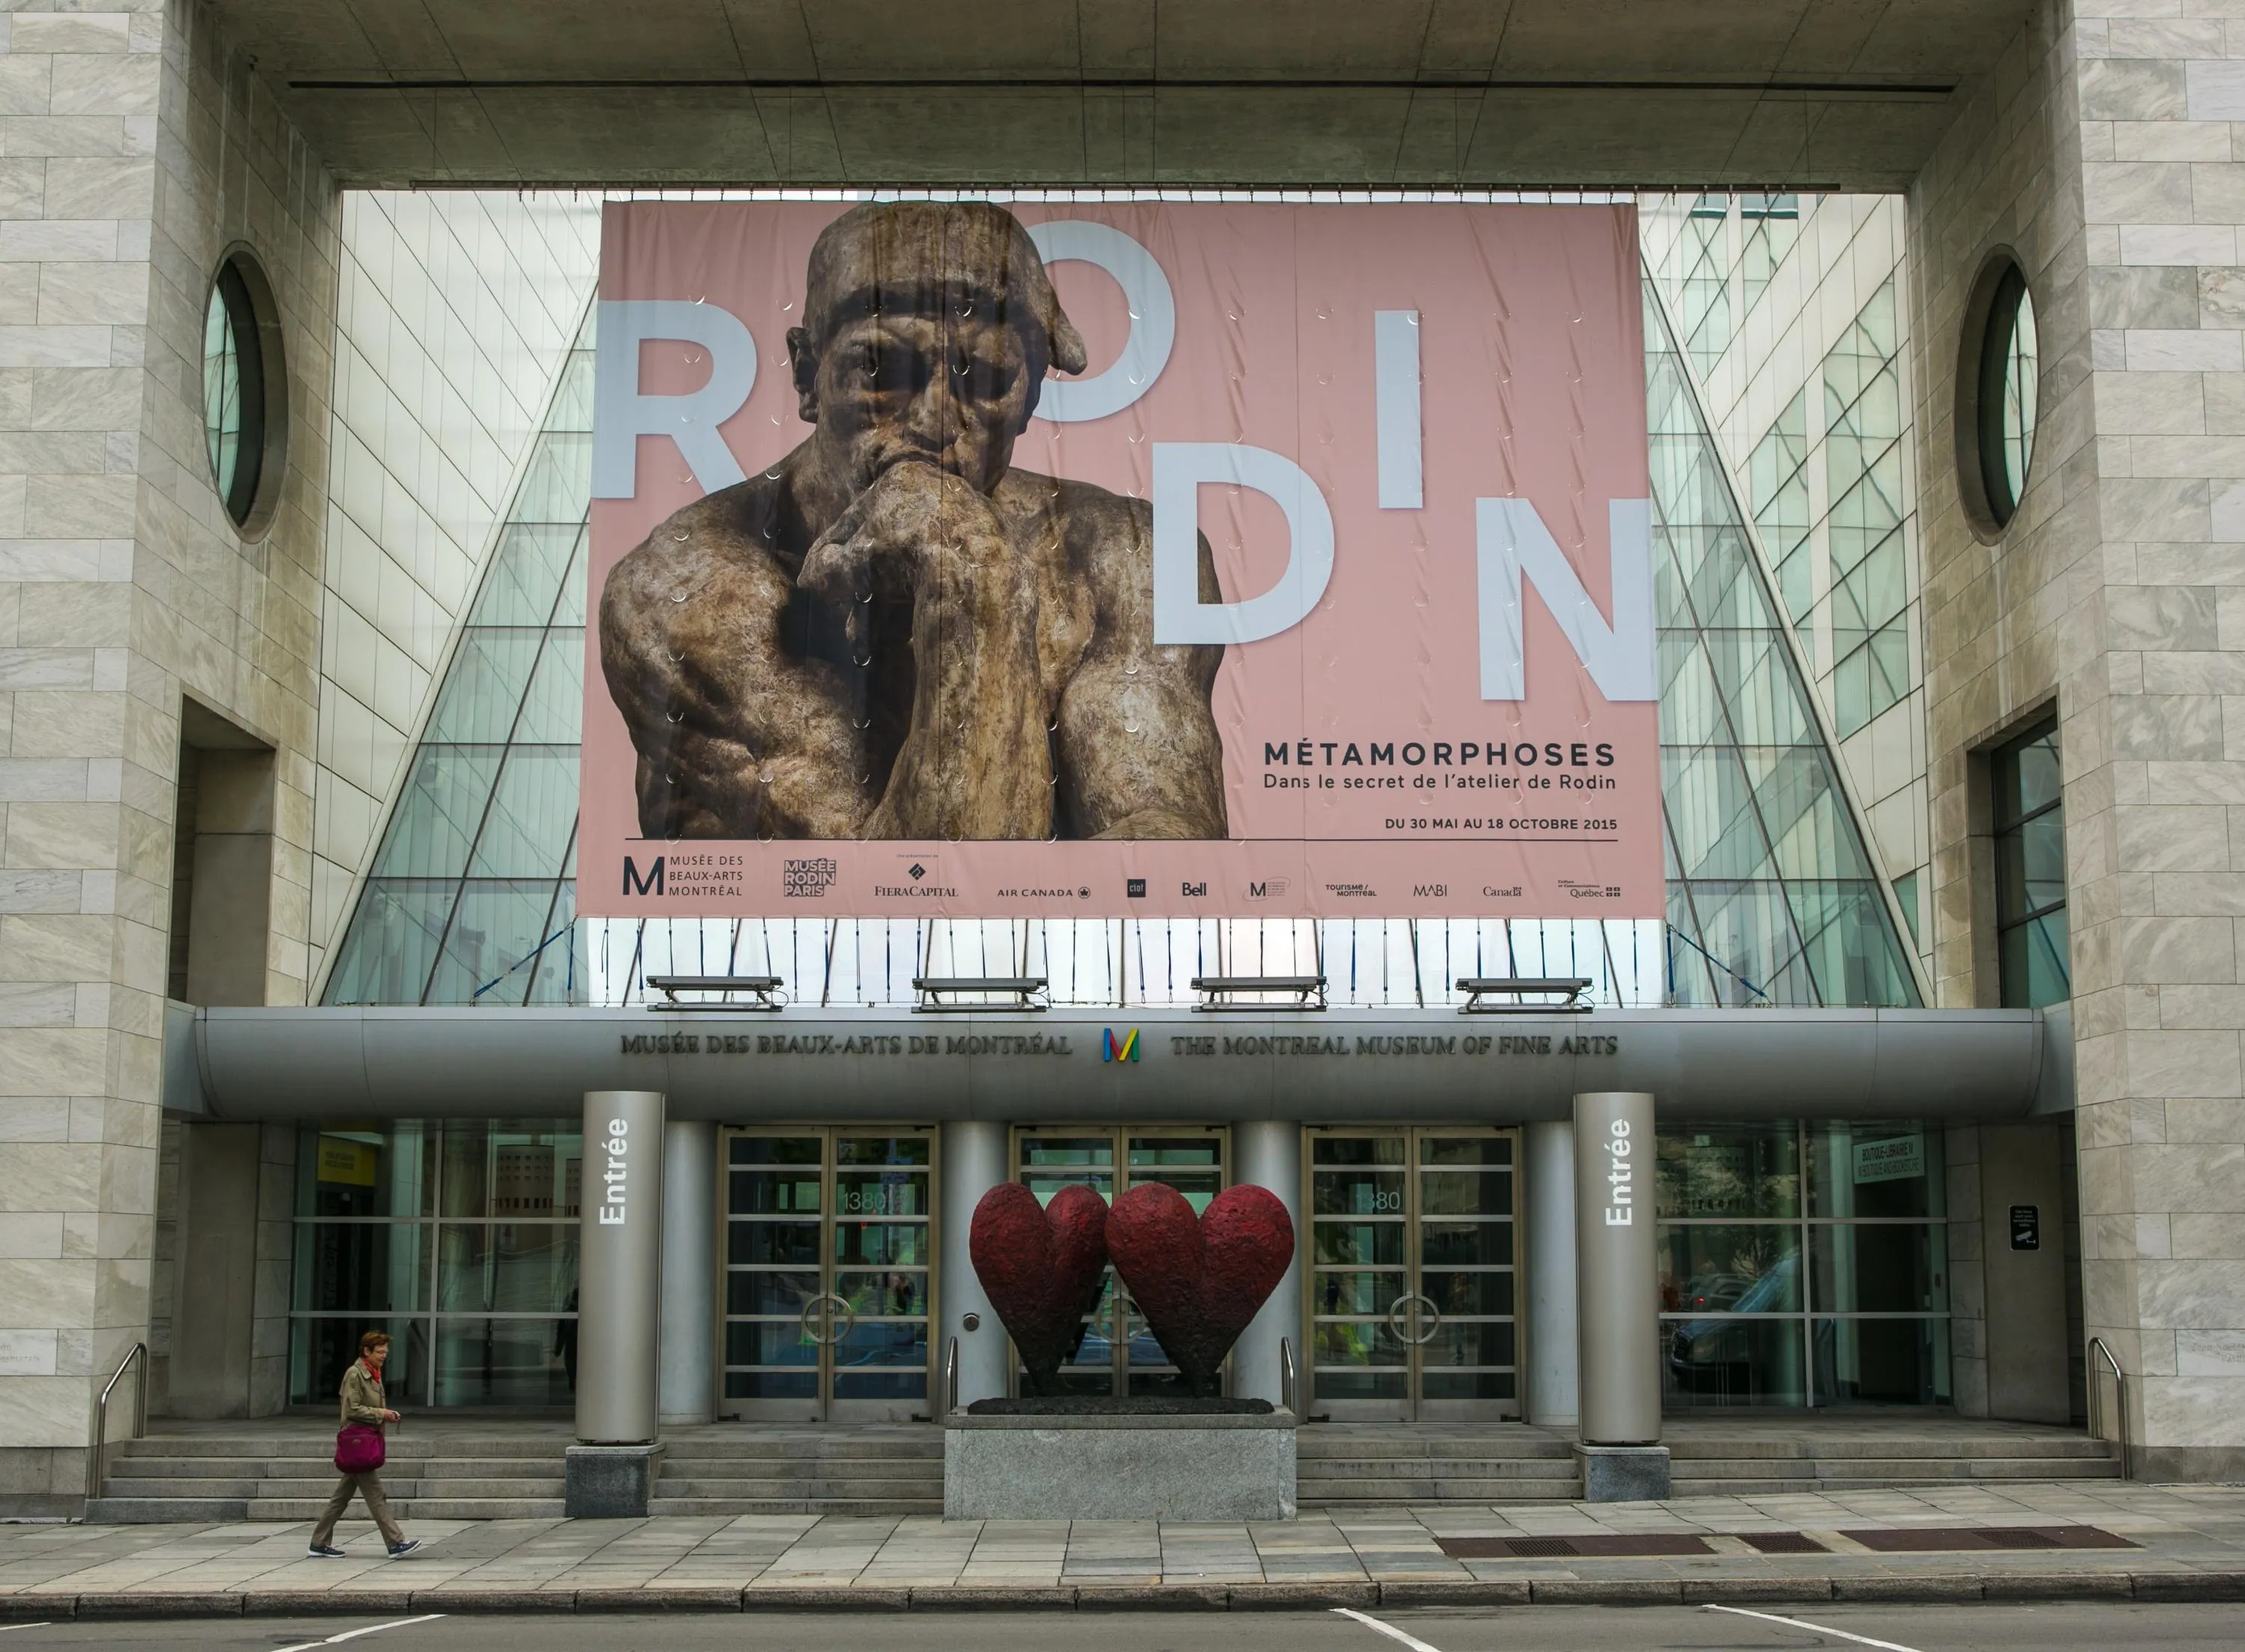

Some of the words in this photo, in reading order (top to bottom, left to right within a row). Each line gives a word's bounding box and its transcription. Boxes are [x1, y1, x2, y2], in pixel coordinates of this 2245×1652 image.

[1265, 738, 1615, 766] MÉTAMORPHOSES
[1264, 774, 1310, 789] Dans
[1319, 774, 1335, 789] le
[1344, 775, 1405, 789] secret
[1414, 774, 1436, 789] de
[1527, 774, 1551, 789] de
[1560, 774, 1616, 789] Rodin
[1385, 819, 1405, 829] DU
[1410, 819, 1427, 829] 30
[1432, 819, 1458, 829] MAI
[1464, 819, 1482, 829] AU
[1488, 819, 1504, 829] 18
[1509, 819, 1578, 830] OCTOBRE
[1583, 819, 1617, 830] 2015
[670, 854, 713, 866] MUSÉE
[719, 856, 743, 866] DES
[784, 858, 836, 872] MUSÉE
[622, 856, 665, 896] M
[669, 871, 743, 881] BEAUX-ARTS
[784, 872, 835, 885] RODIN
[669, 884, 742, 896] MONTRÉAL
[784, 885, 824, 896] PARIS
[997, 889, 1018, 897] AIR
[1021, 889, 1073, 897] CANADA
[1182, 882, 1207, 896] Bell
[1250, 881, 1266, 896] M
[1483, 886, 1522, 897] Canada
[1570, 888, 1604, 898] Québec
[620, 1031, 700, 1055] MUSÉE
[706, 1035, 750, 1055] DES
[757, 1035, 902, 1055] BEAUX-ARTS
[908, 1035, 939, 1055] DE
[945, 1032, 1073, 1056] MONTRÉAL
[1103, 1028, 1140, 1062] M
[1170, 1035, 1216, 1056] THE
[1223, 1035, 1351, 1056] MONTREAL
[1357, 1035, 1456, 1056] MUSEUM
[1462, 1035, 1492, 1056] OF
[1499, 1035, 1551, 1056] FINE
[1559, 1035, 1619, 1056] ARTS
[600, 1118, 628, 1226] Entrée
[1604, 1119, 1632, 1226] Entrée
[842, 1192, 886, 1210] 1380
